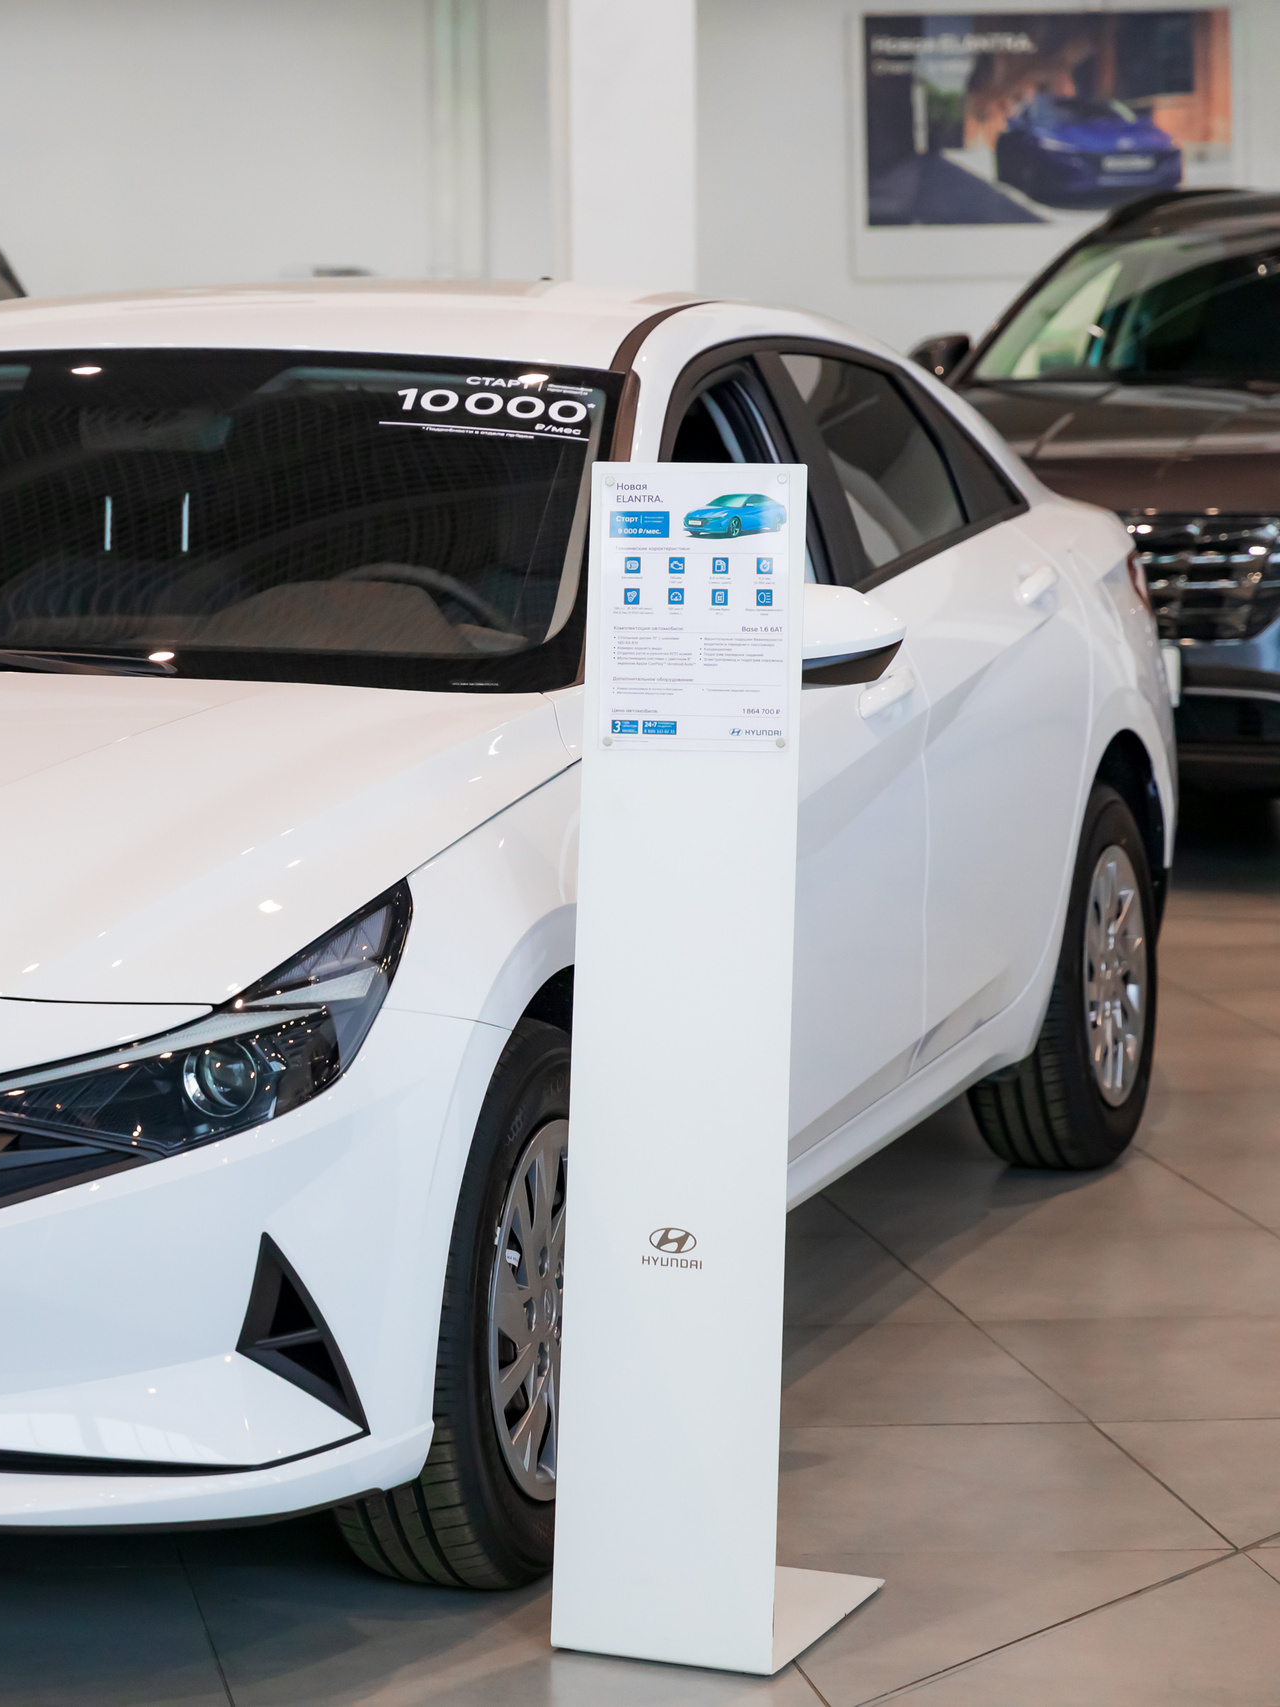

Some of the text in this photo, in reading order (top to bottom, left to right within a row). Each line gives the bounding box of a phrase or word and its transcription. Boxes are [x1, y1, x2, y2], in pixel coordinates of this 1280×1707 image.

[616, 482, 648, 491] Новая
[616, 494, 664, 503] ELANTRA.
[616, 515, 639, 523] Старт
[613, 720, 621, 732] 3
[641, 1255, 703, 1270] HYUNDAI
